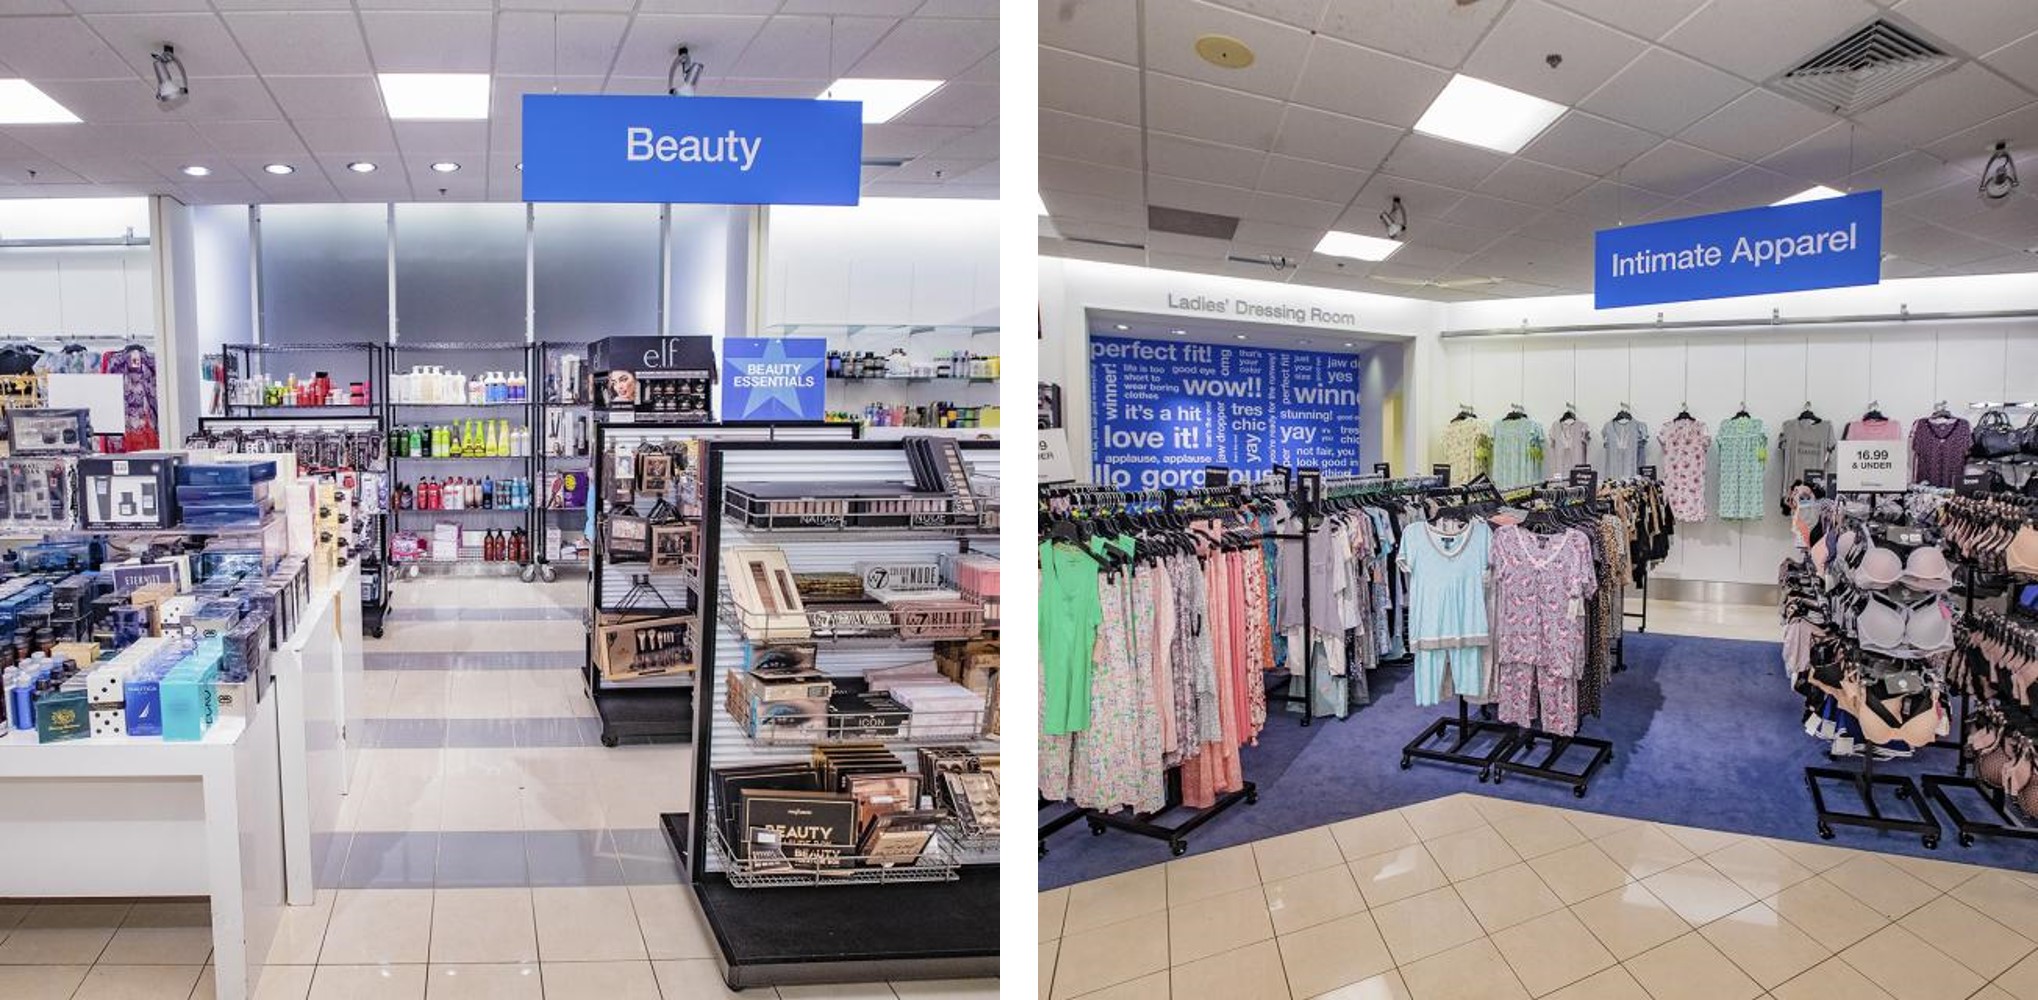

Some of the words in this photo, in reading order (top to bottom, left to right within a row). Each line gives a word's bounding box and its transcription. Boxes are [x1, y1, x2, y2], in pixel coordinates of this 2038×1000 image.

[626, 126, 762, 171] Beauty
[1611, 243, 1722, 278] Intimate
[1729, 221, 1857, 268] Apparel
[1167, 292, 1229, 314] Ladies'
[1235, 299, 1306, 323] Dressing
[1310, 306, 1356, 326] Room
[1090, 340, 1177, 360] perfect
[1183, 344, 1212, 363] fit!
[1220, 349, 1233, 376] omg
[1327, 357, 1347, 369] jaw
[747, 364, 801, 375] BEAUTY
[1150, 365, 1165, 374] too
[1172, 365, 1197, 375] good
[1198, 367, 1216, 376] eye
[733, 376, 815, 388] ESSENTIALS
[1123, 373, 1149, 382] short
[1327, 371, 1353, 384] yes
[1102, 363, 1118, 420] winner!
[1150, 383, 1180, 393] boring
[1182, 376, 1262, 398] wow!!
[1280, 369, 1291, 405] perfect
[1123, 391, 1160, 400] clothes
[1124, 404, 1154, 420] it's
[1160, 408, 1172, 421] a
[1177, 405, 1202, 421] hit
[1232, 403, 1262, 417] tres
[1280, 409, 1333, 422] stunning!
[1216, 401, 1228, 442] dropper
[1232, 418, 1267, 431] chic
[1104, 424, 1165, 449] love
[1173, 426, 1199, 449] it!
[1280, 425, 1316, 444] yay
[1216, 444, 1228, 464] jaw
[1246, 433, 1262, 463] yay
[1296, 448, 1314, 456] not
[1337, 449, 1355, 458] you
[1105, 454, 1161, 465] applause,
[1163, 454, 1212, 464] applause
[1857, 450, 1889, 460] 16.99
[1296, 457, 1319, 466] look
[1321, 457, 1347, 469] good
[1349, 459, 1359, 467] in
[1851, 462, 1858, 470] &
[1860, 461, 1892, 470] UNDER
[858, 718, 886, 726] ICON
[794, 849, 841, 860] BEAUTY
